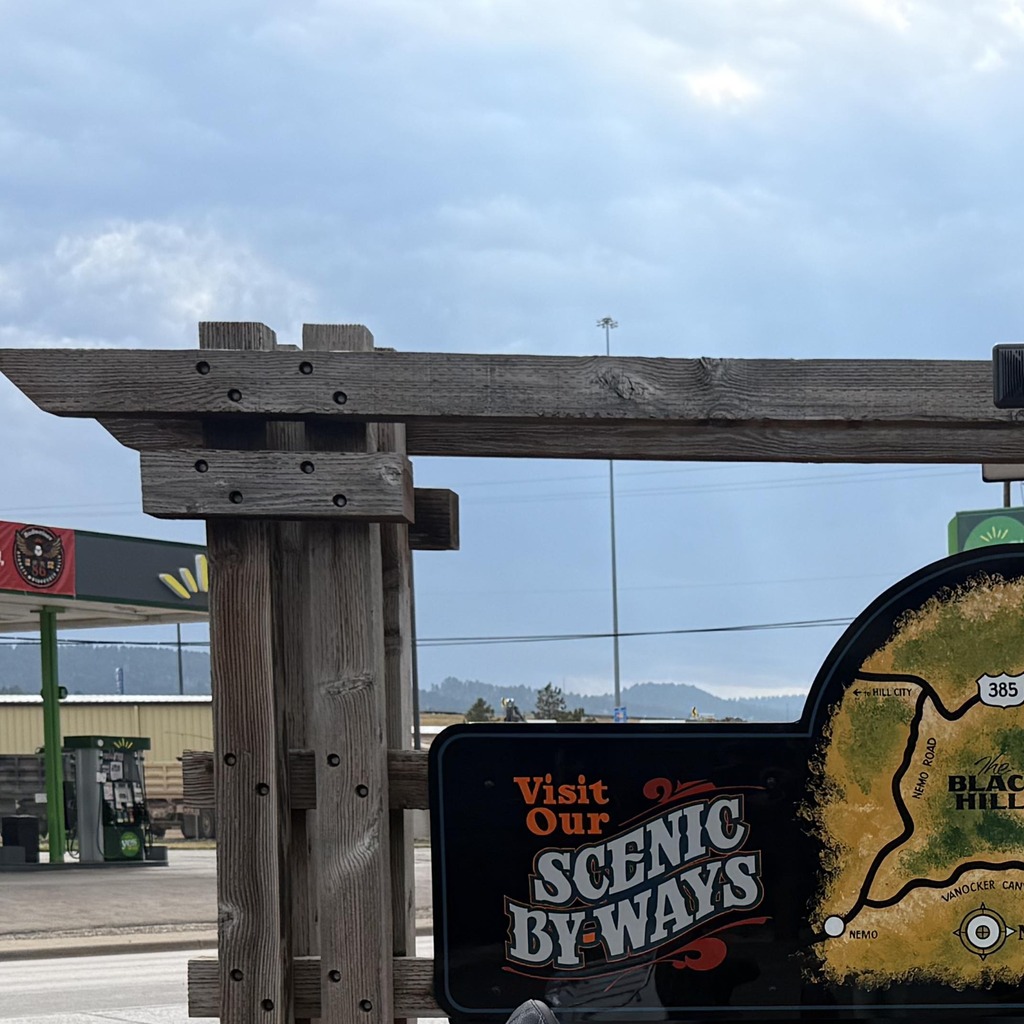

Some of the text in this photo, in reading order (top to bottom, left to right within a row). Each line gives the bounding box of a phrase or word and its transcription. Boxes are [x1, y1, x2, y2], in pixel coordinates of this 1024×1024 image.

[872, 688, 892, 696] HILL
[893, 688, 913, 696] CITY
[988, 682, 1018, 697] 385
[912, 737, 937, 799] NEMO ROAD
[974, 752, 1012, 776] The
[514, 774, 610, 805] Visit
[526, 807, 610, 836] Our
[533, 797, 747, 904] SCENIC
[941, 880, 995, 902] VANOCKER
[508, 854, 760, 966] BY-WAYS
[850, 930, 878, 940] NEMO
